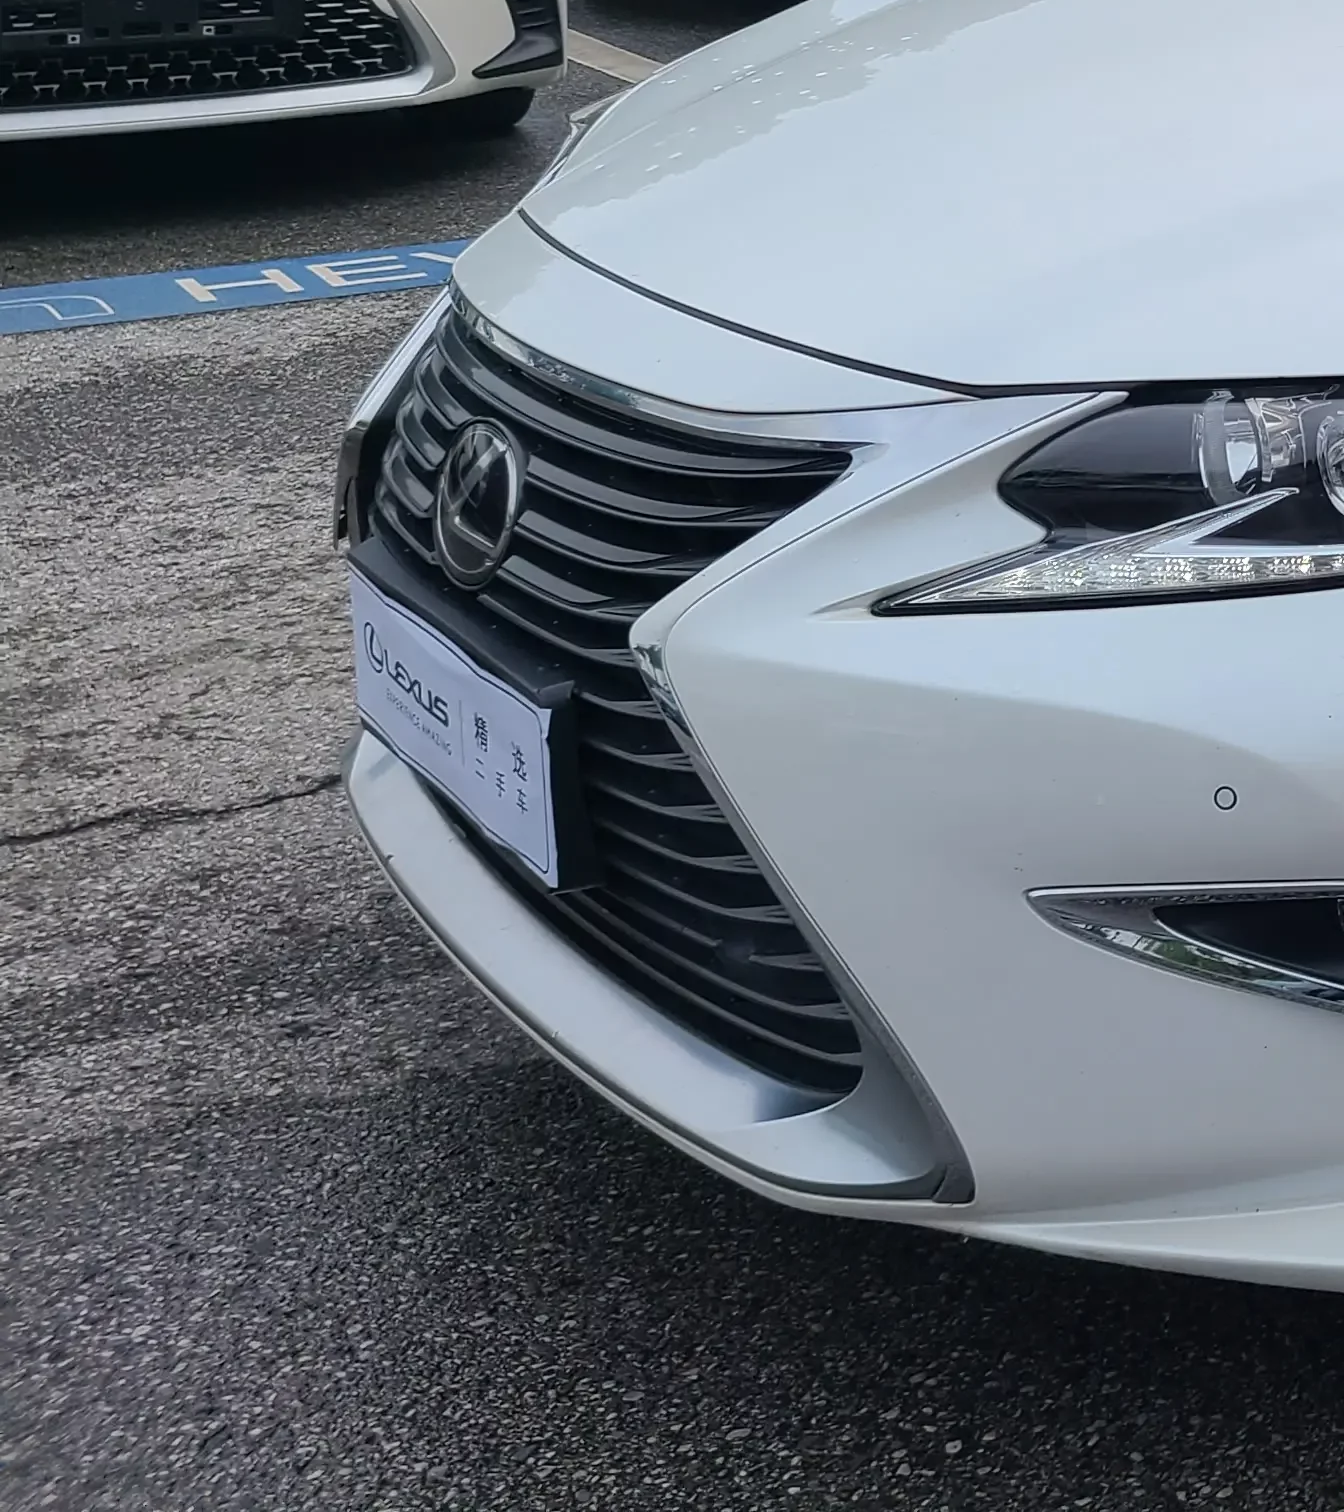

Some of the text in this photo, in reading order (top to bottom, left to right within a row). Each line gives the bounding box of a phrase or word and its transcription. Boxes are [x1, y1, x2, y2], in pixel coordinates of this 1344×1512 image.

[175, 252, 456, 302] HE
[384, 649, 450, 728] LEXUS
[474, 758, 528, 814] 二手车
